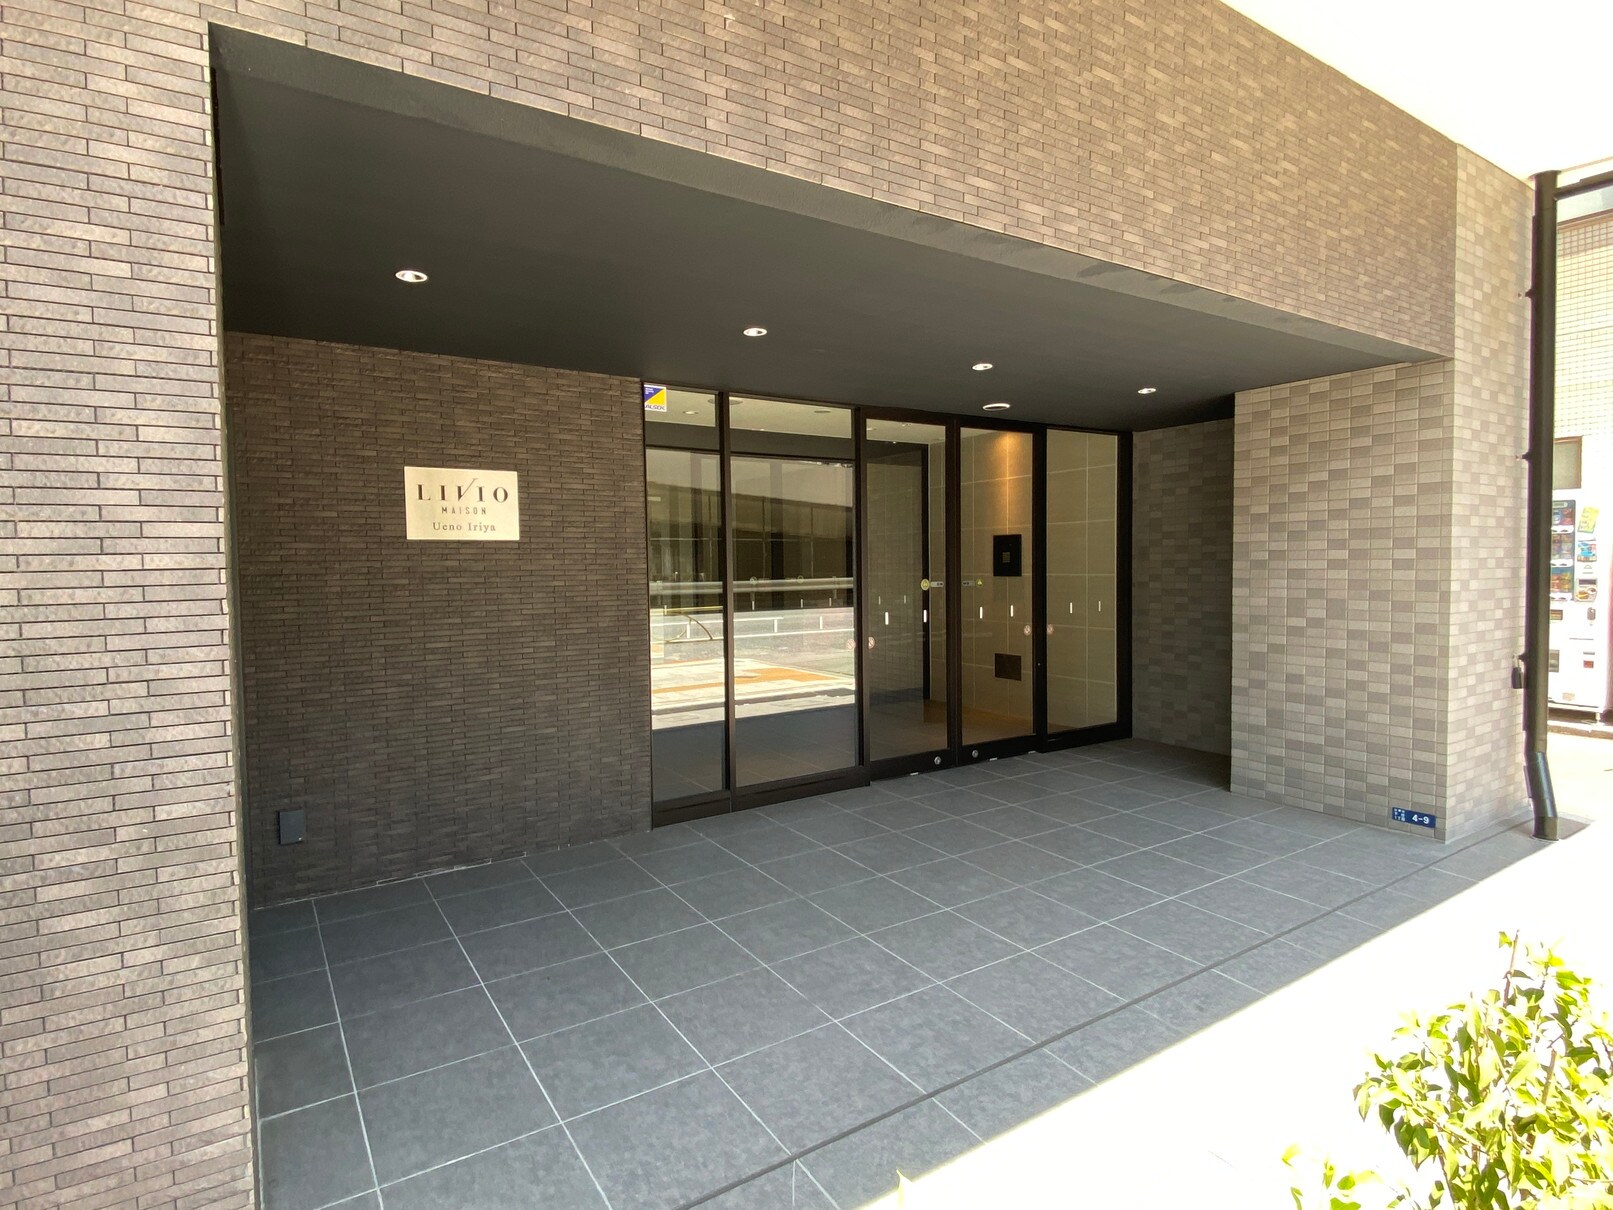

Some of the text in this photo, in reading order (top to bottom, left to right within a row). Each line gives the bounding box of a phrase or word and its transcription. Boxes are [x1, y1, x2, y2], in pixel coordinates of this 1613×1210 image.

[416, 478, 509, 503] LIVIO
[441, 506, 487, 515] MAISON
[432, 522, 496, 533] Ueno Iriya
[1411, 814, 1430, 824] 4-9
